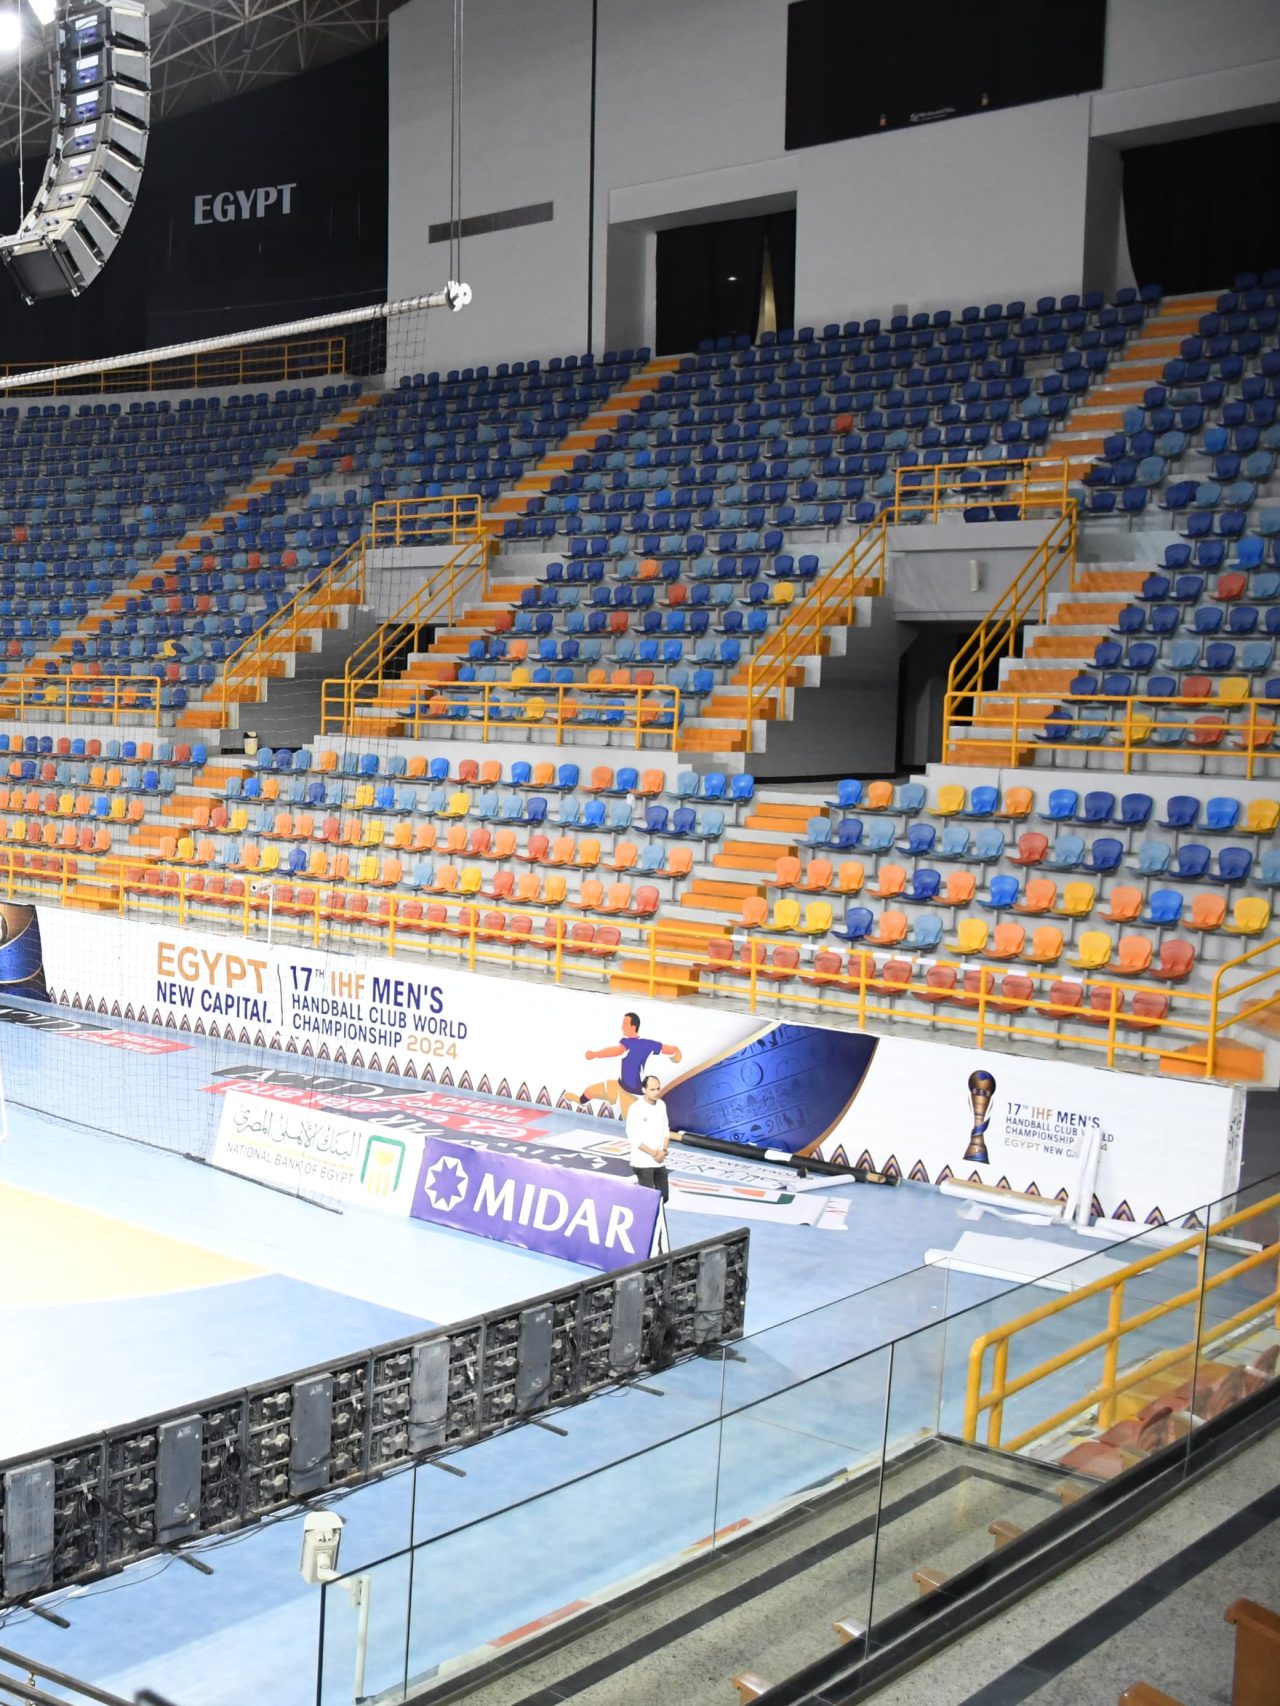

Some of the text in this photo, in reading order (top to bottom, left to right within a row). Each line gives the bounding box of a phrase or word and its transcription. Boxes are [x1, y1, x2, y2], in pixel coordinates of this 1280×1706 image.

[194, 182, 297, 225] EGYPT
[157, 942, 267, 994] EGYPT
[157, 980, 272, 1024] NEW CAPITAL
[331, 970, 365, 1000] IHF
[372, 976, 444, 1014] MEN'S
[292, 993, 468, 1040] HANDBALL CLUB WORLD
[292, 1013, 458, 1060] CHAMPIONSHIP 2024
[445, 1094, 521, 1114] DREAM
[466, 1107, 522, 1124] TRUE
[1031, 1106, 1053, 1121] IHF
[1056, 1110, 1100, 1129] MEN'S
[1004, 1137, 1041, 1151] EGYPT
[1044, 1145, 1063, 1156] NEW
[1005, 1125, 1075, 1145] CHAMPIONSHIP
[1006, 1115, 1051, 1132] HANDBALL
[1054, 1124, 1078, 1137] CLUB
[226, 1141, 355, 1186] NATIONAL BANK OF EGYPT
[473, 1173, 635, 1255] MIDAR
